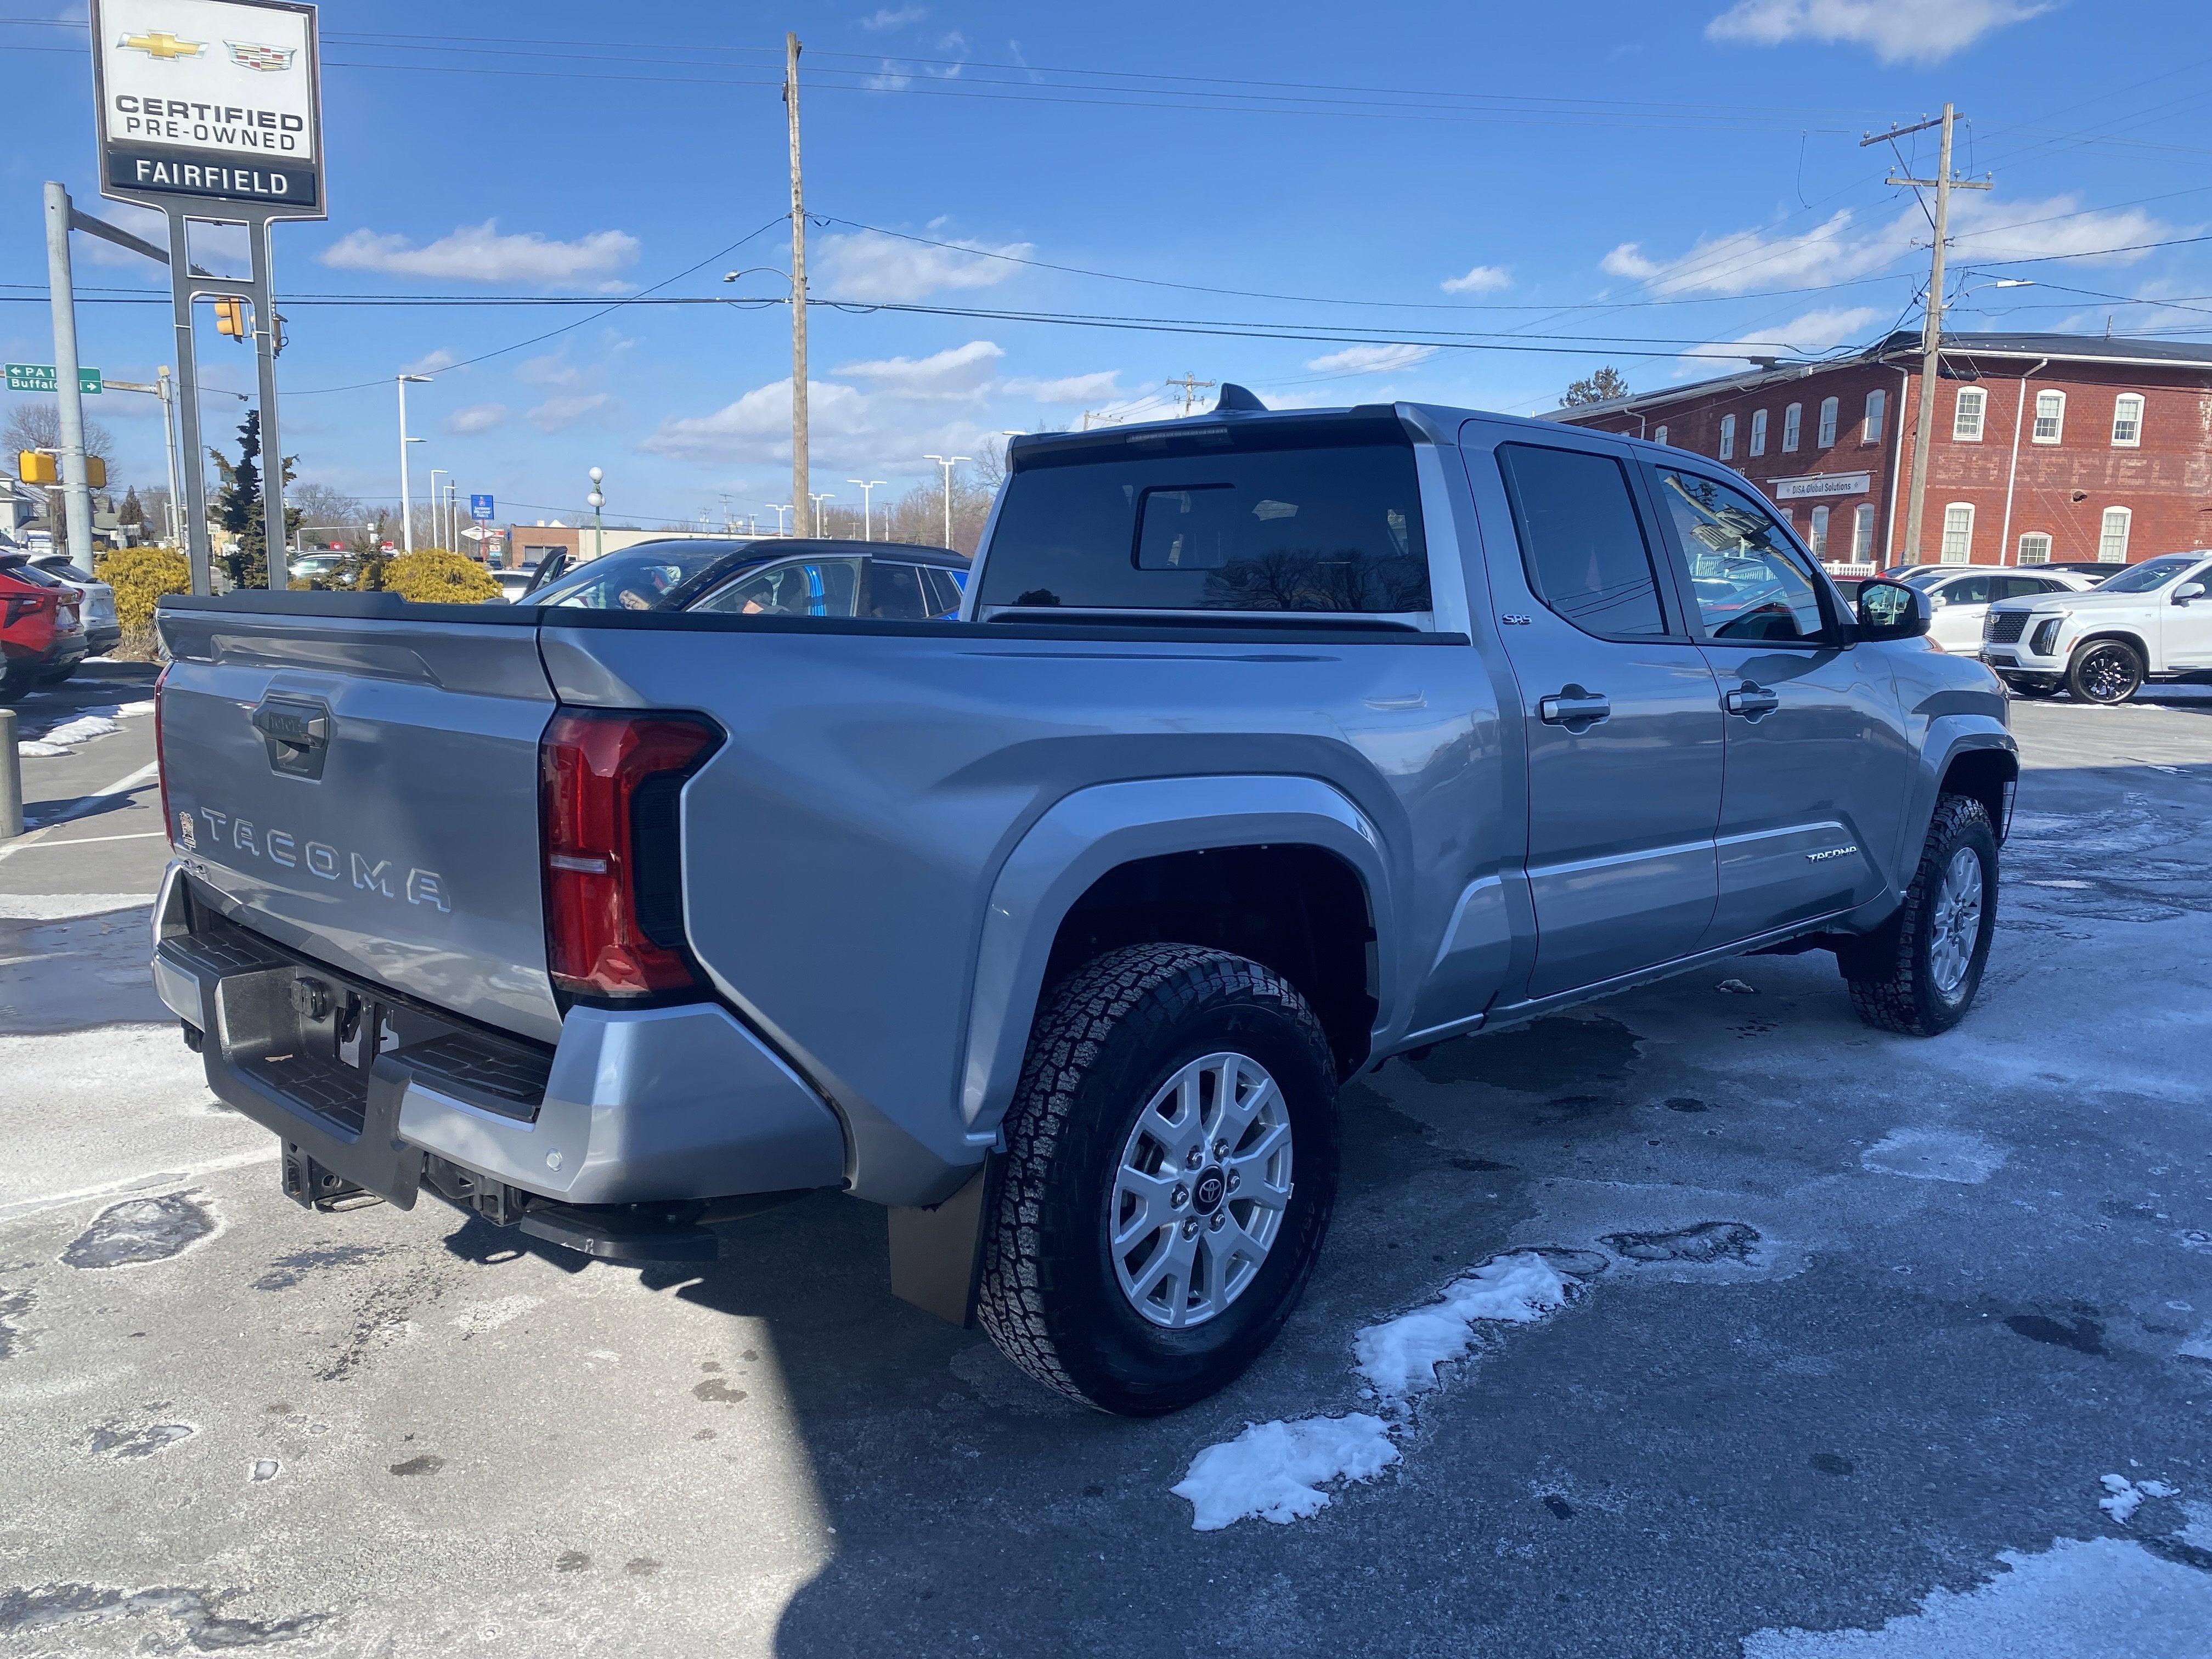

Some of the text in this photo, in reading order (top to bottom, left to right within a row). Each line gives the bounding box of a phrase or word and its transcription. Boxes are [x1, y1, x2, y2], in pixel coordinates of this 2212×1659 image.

[116, 95, 303, 132] CERTIFIED
[126, 117, 295, 150] PRE-OWNED
[136, 159, 288, 194] FAIRFIELD
[25, 367, 46, 377] PA
[1792, 482, 1851, 494] DISA Global Solutions
[1502, 614, 1532, 625] SR5
[201, 806, 452, 913] TACOMA
[1805, 846, 1857, 864] TACOMA
